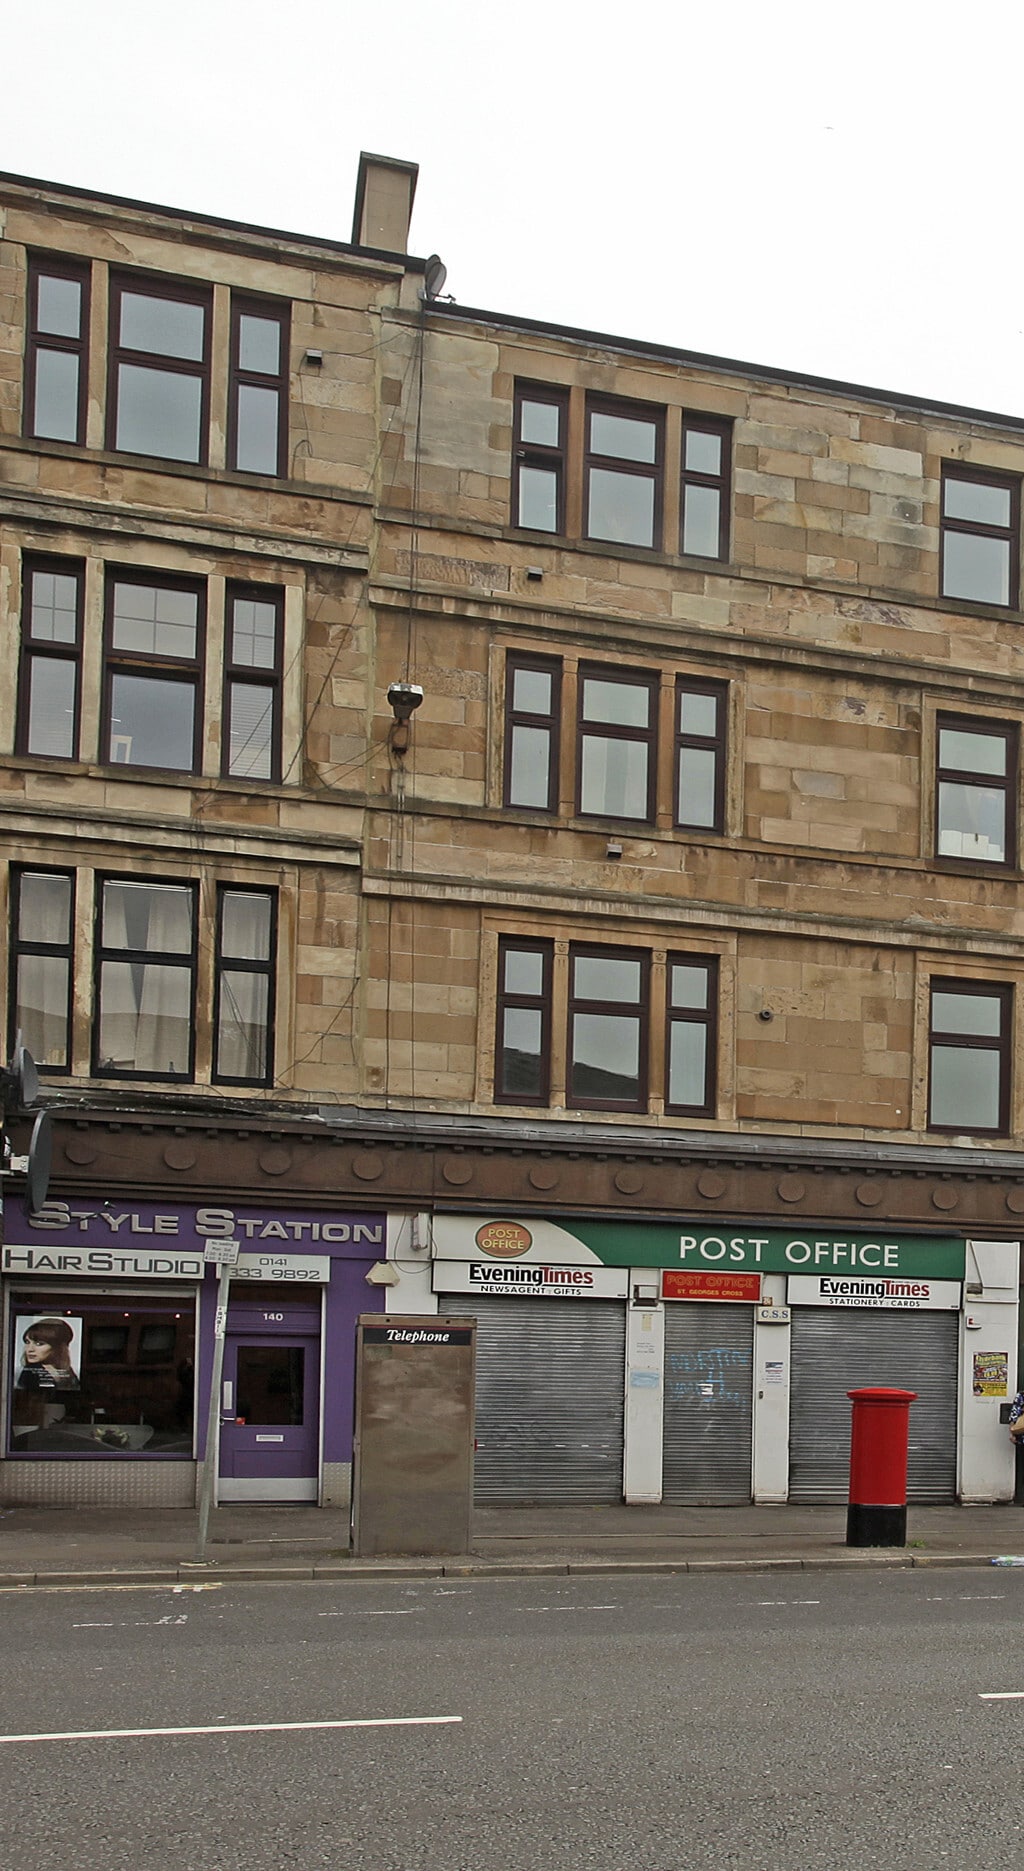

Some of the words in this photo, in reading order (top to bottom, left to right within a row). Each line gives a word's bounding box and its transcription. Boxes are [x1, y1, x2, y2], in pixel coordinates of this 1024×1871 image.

[29, 1201, 179, 1234] STYLE
[195, 1208, 382, 1243] STATION
[487, 1228, 520, 1239] POST
[481, 1239, 525, 1250] OFFICE
[680, 1236, 769, 1261] POST
[785, 1241, 899, 1267] OFFICE
[259, 1257, 288, 1266] 0141
[229, 1267, 262, 1278] 333
[271, 1269, 320, 1280] 9892
[666, 1275, 702, 1286] POST
[705, 1276, 754, 1288] OFFICE
[480, 1285, 546, 1294] NEWSAGENT
[553, 1287, 582, 1295] GIFTS
[829, 1298, 884, 1306] STATIONERY
[891, 1299, 921, 1308] CARDS
[263, 1313, 284, 1321] 140
[386, 1329, 450, 1343] Telephone
